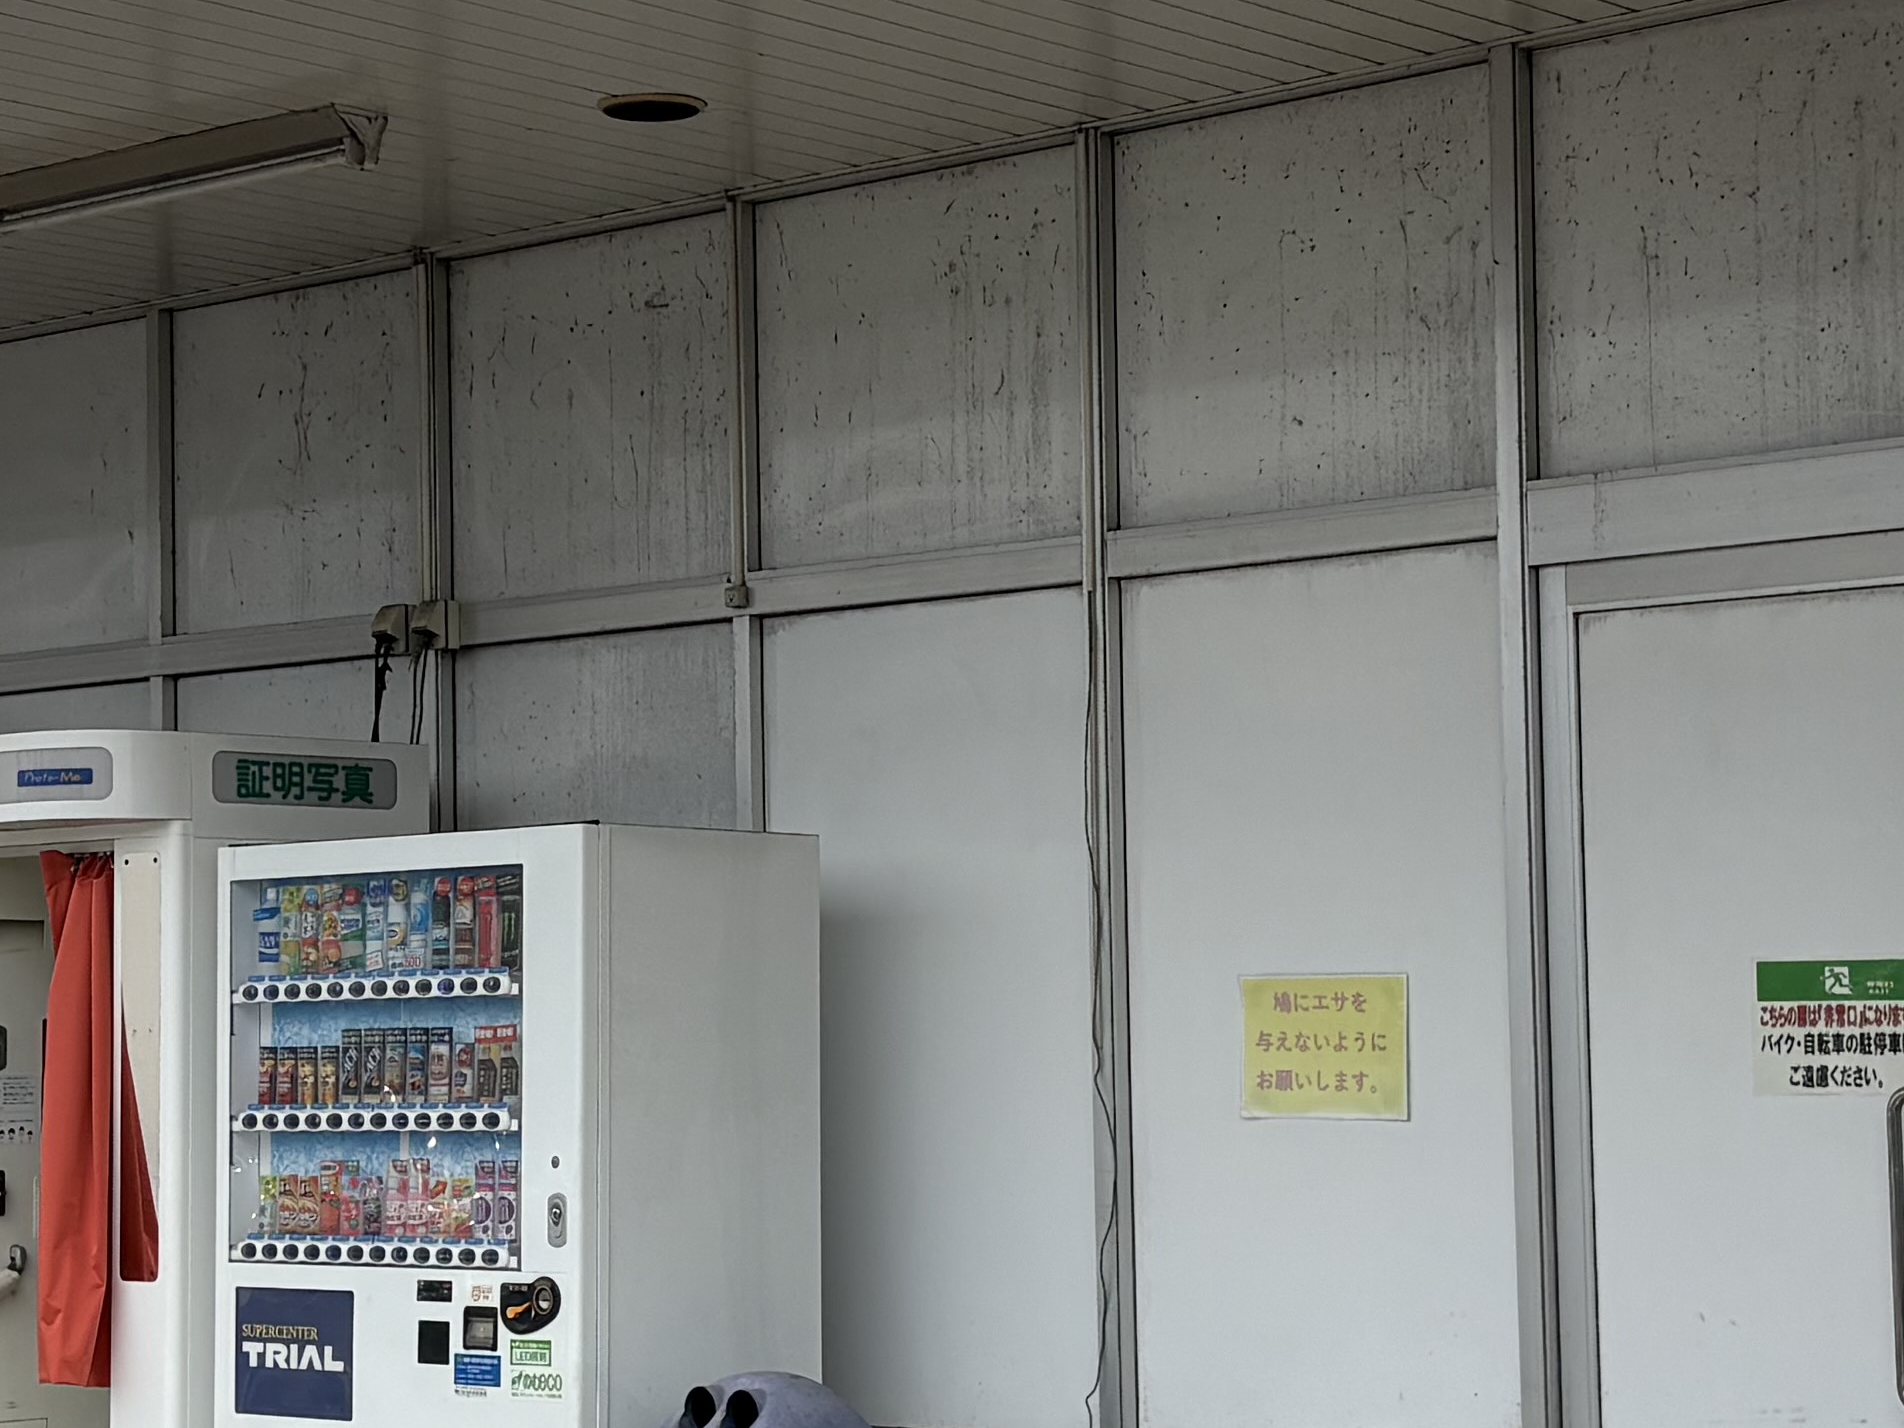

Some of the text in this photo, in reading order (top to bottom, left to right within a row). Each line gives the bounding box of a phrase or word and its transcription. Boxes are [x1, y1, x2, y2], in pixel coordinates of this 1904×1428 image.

[236, 759, 374, 805] 証明写真
[1273, 991, 1368, 1014] 鳩にエサを
[1255, 1030, 1387, 1053] 与えないように
[1256, 1069, 1378, 1094] お願いします。
[1788, 1064, 1883, 1089] ご遠慮ください。
[242, 1323, 319, 1341] SUPERCENTER
[242, 1341, 345, 1373] TRIAL
